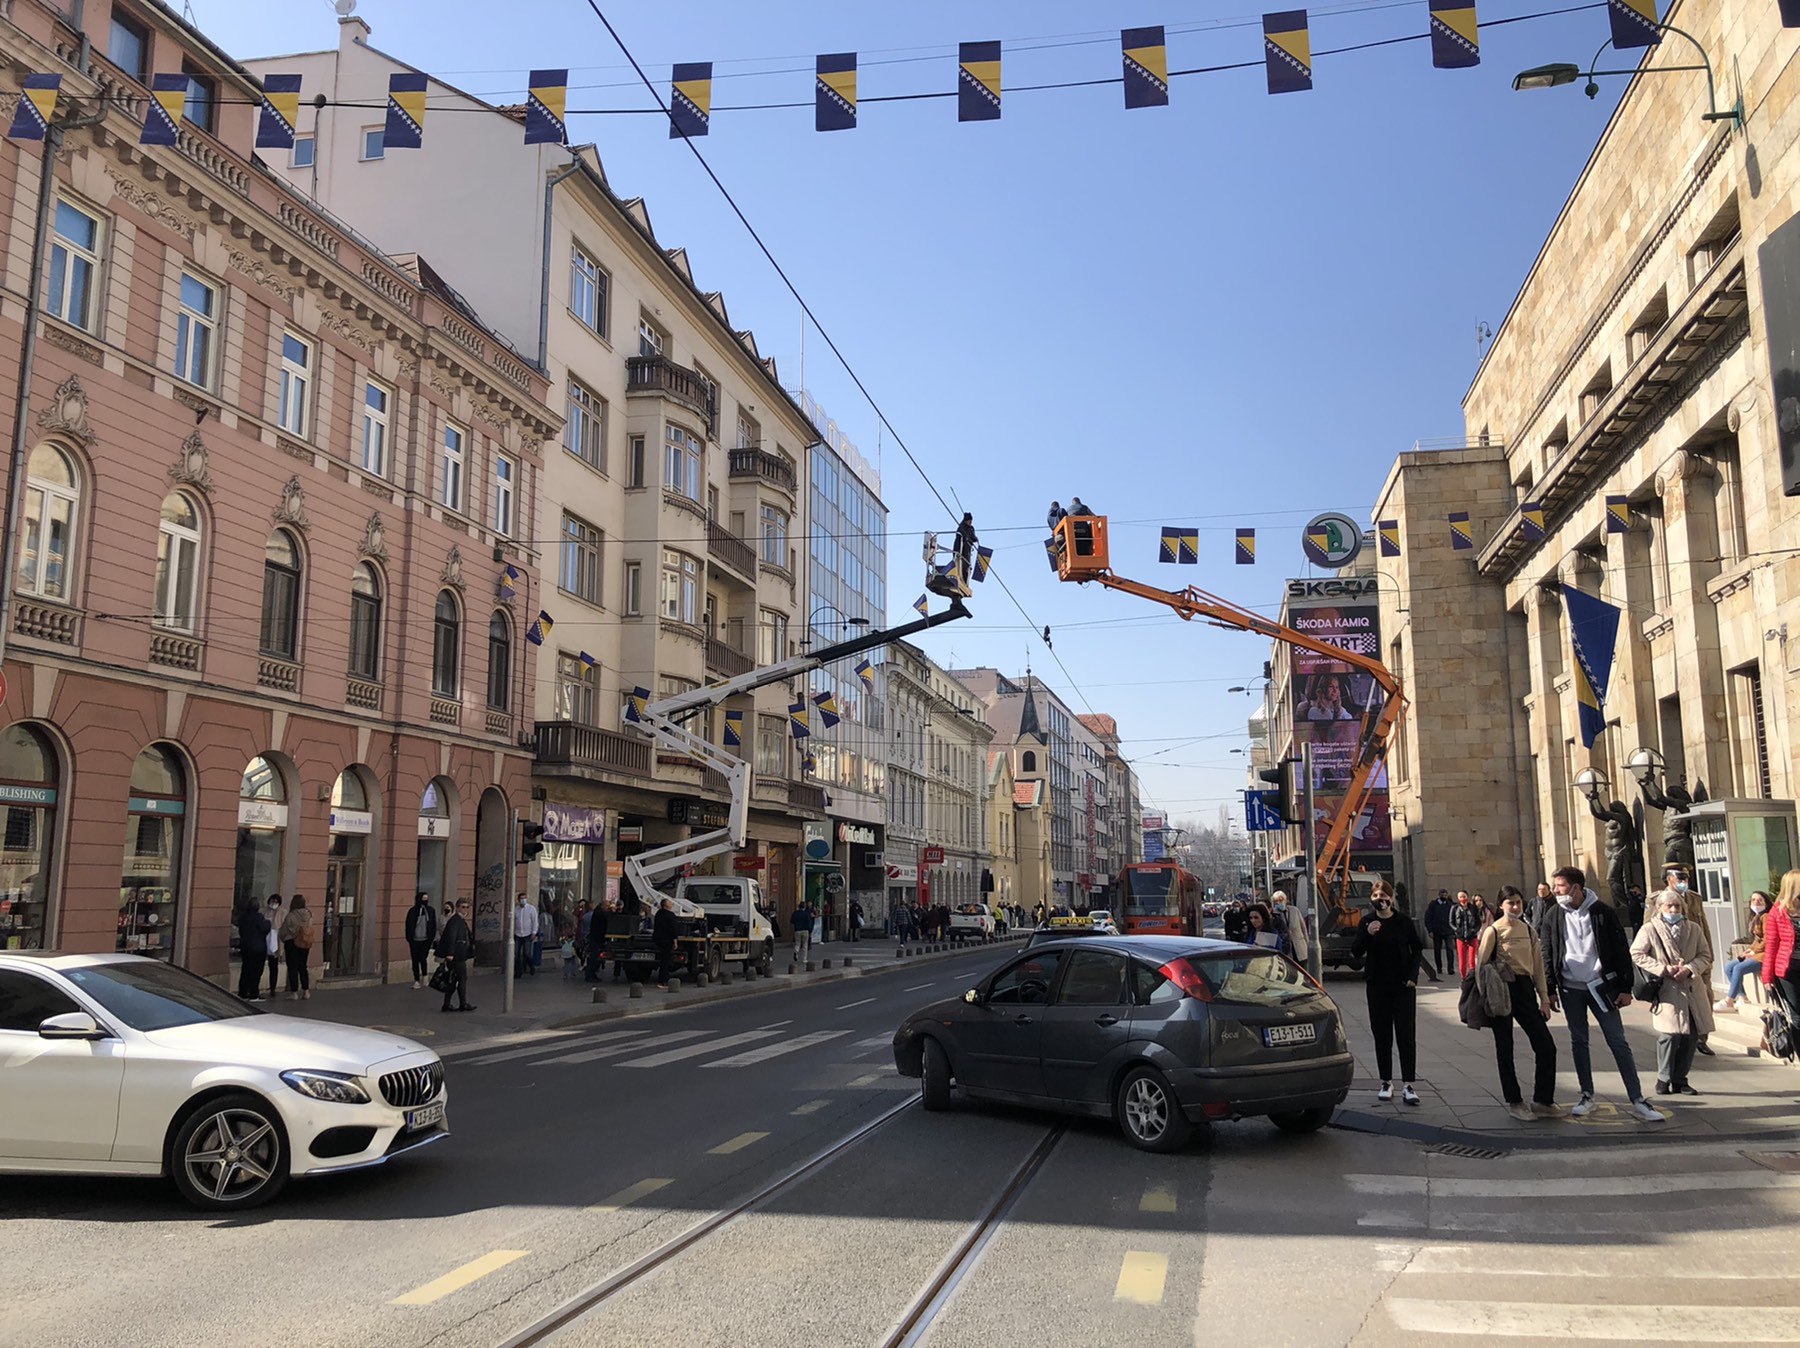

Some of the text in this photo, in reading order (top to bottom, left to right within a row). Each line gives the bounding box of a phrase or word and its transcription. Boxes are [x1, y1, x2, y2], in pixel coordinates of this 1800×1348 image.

[1296, 617, 1369, 629] ŠKODA KAMIQ
[0, 788, 46, 801] BLISHING
[1269, 1025, 1315, 1041] E13-T-511
